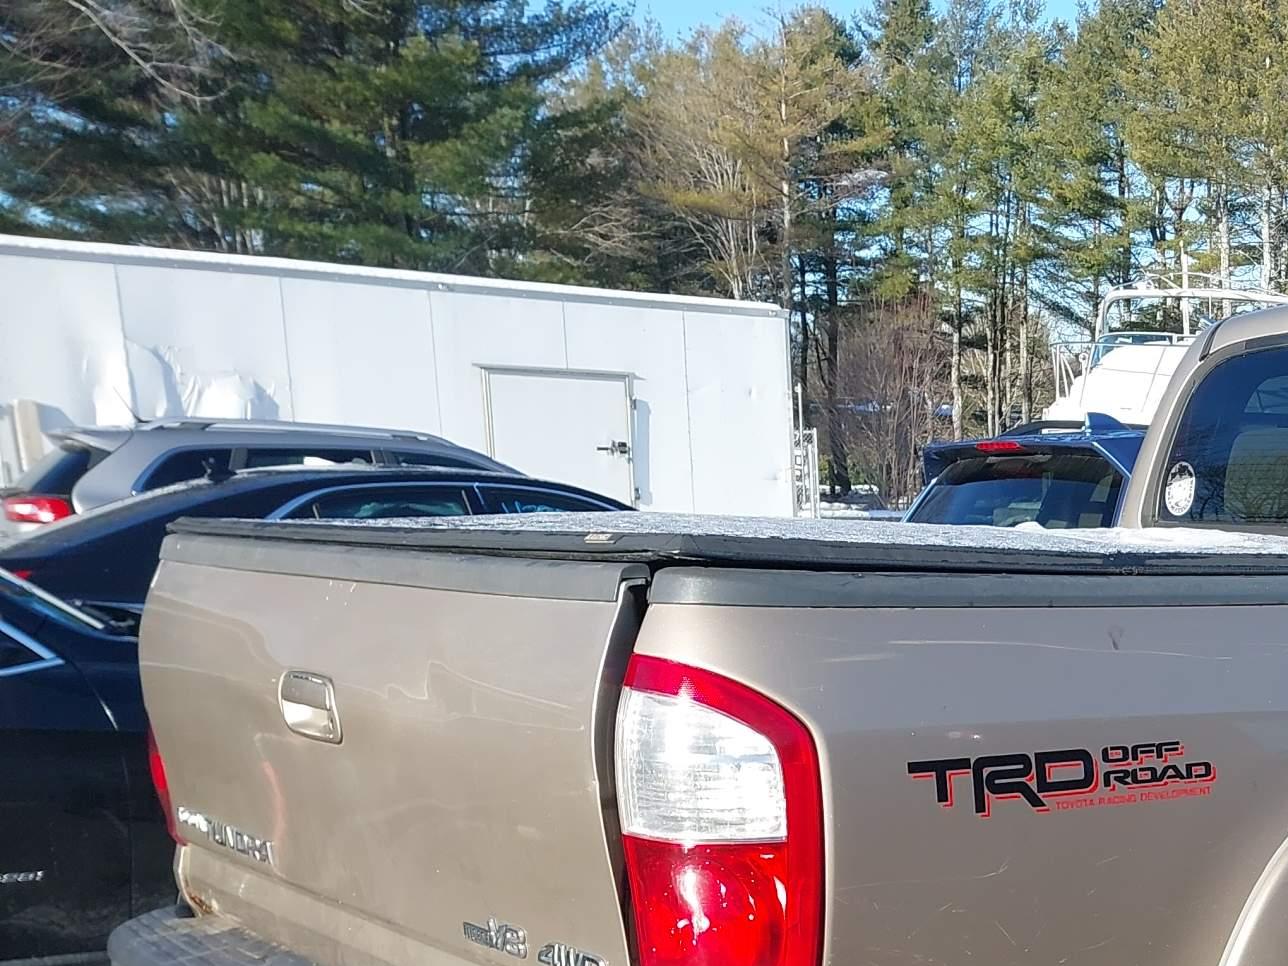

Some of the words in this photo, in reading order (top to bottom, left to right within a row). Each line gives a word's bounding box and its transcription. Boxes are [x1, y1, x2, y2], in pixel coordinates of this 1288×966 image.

[1101, 741, 1185, 766] OFF
[907, 748, 1100, 819] TRD
[1103, 761, 1217, 791] ROAD
[487, 917, 529, 959] V8
